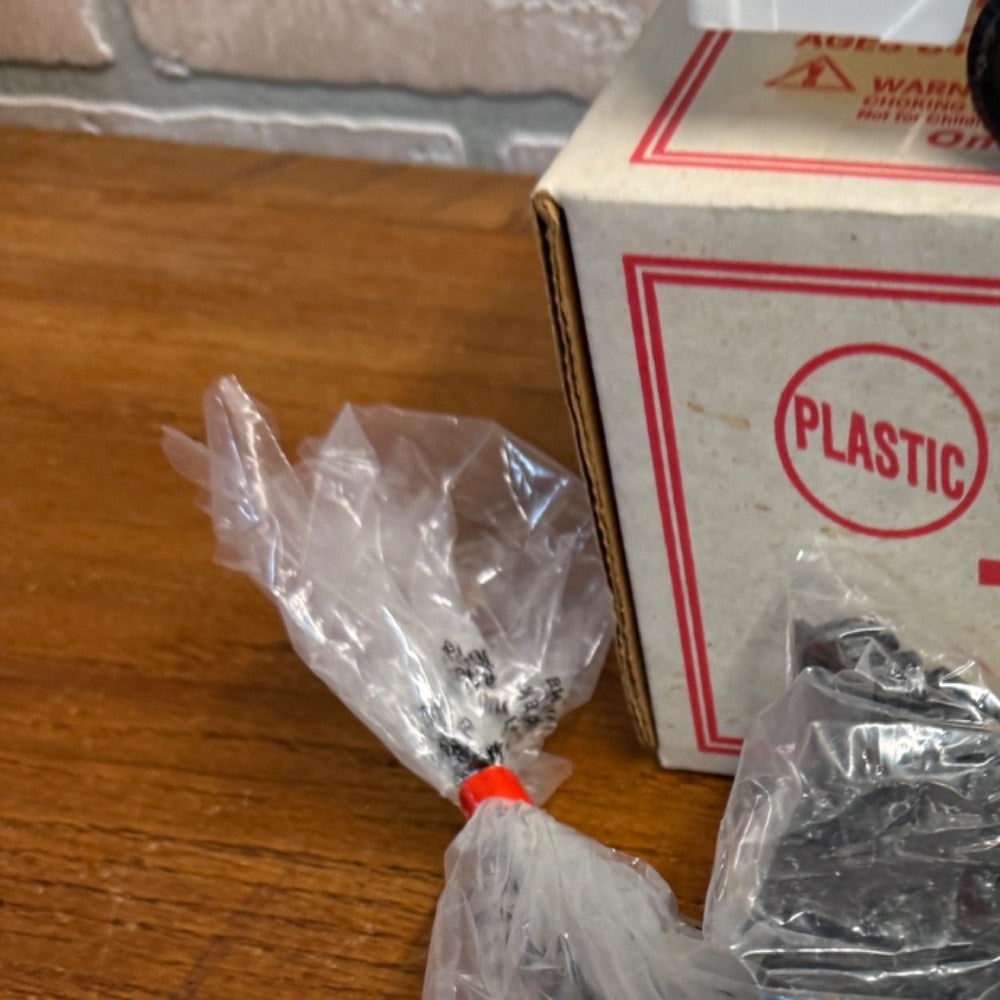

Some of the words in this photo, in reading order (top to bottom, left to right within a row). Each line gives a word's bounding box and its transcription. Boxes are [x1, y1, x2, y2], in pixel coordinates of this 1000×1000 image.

[872, 76, 970, 97] WARN
[926, 129, 994, 150] On
[793, 394, 966, 502] PLASTIC
